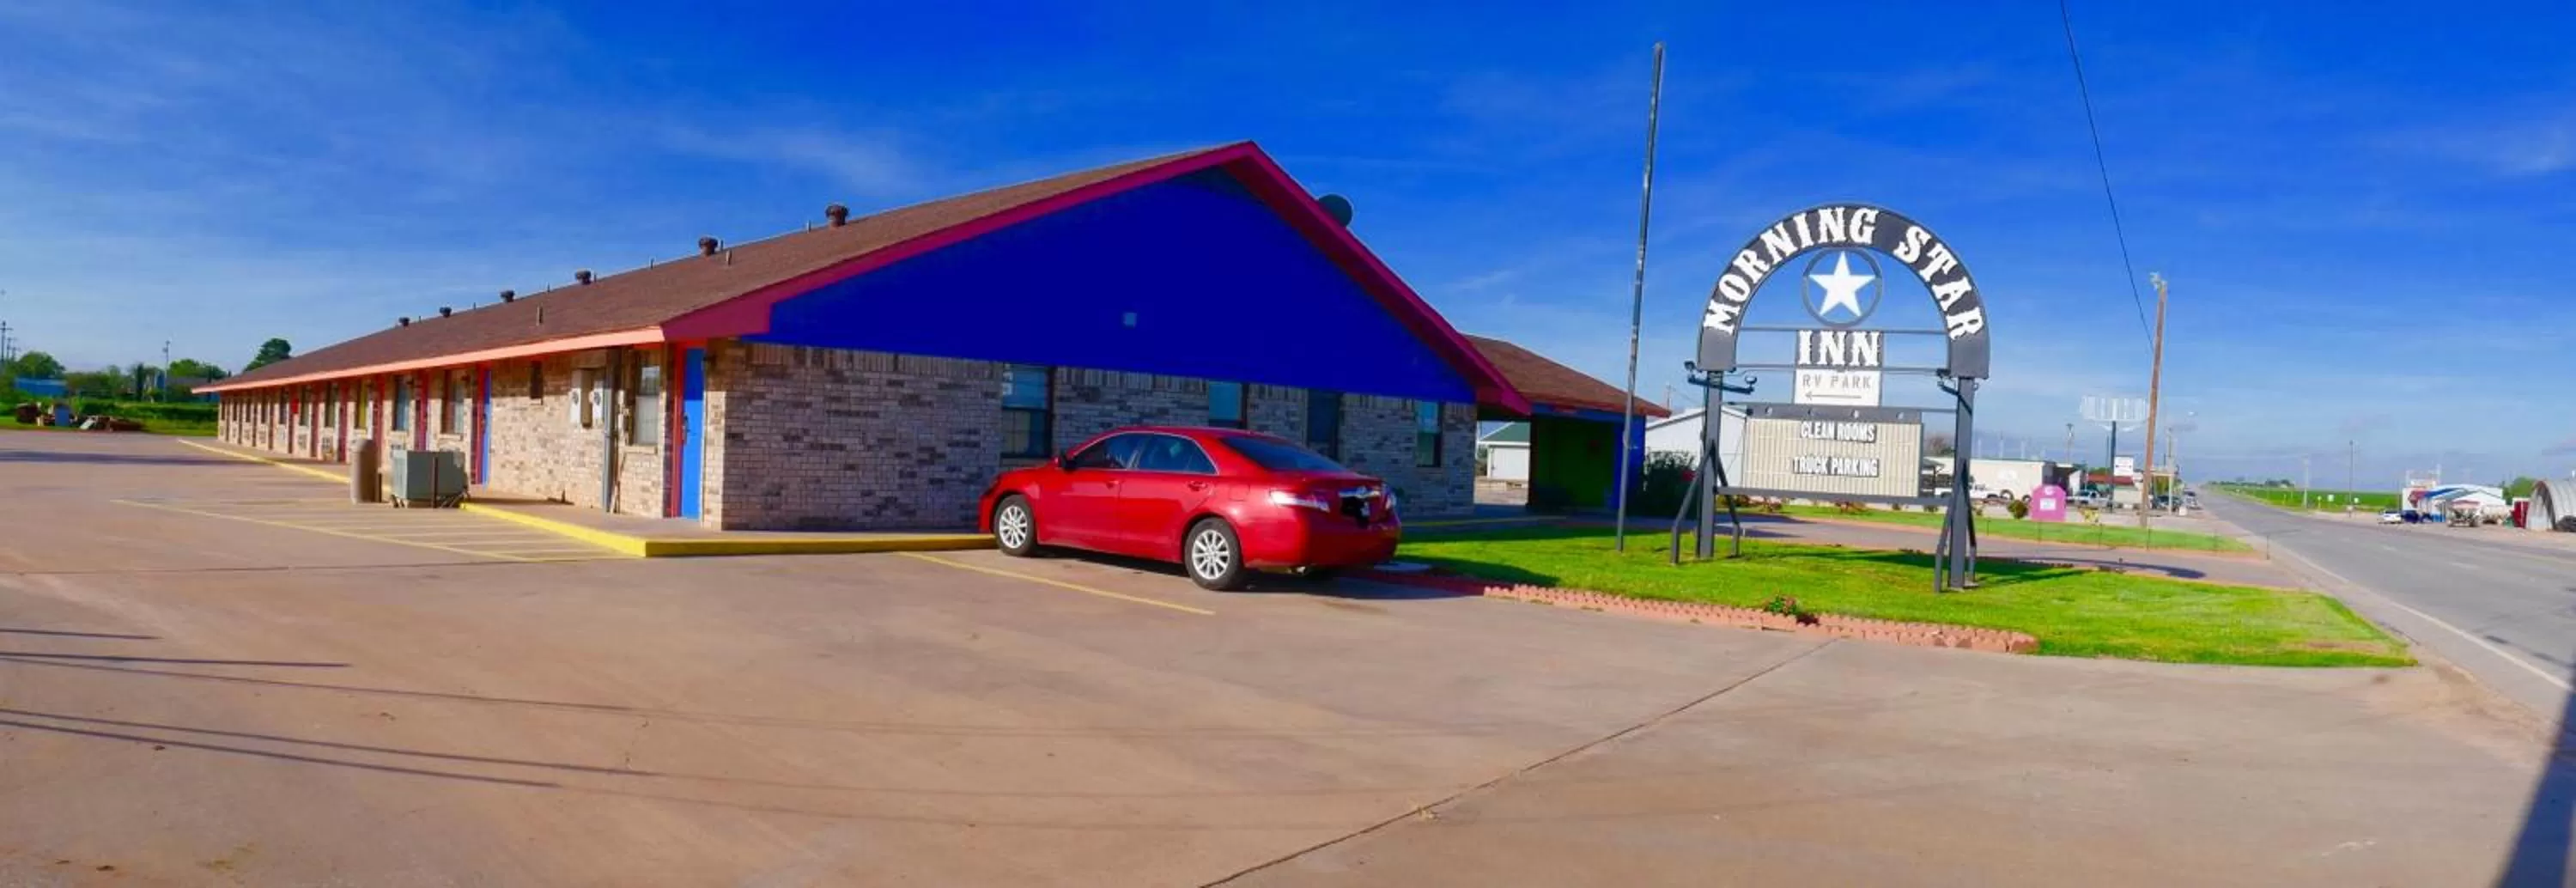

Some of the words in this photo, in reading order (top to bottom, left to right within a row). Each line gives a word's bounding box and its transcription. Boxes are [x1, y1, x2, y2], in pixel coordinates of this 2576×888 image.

[1703, 206, 1880, 335] MORNING
[1893, 225, 1985, 340] STAR
[1798, 330, 1883, 367] INN
[1802, 374, 1822, 387] RV
[1830, 375, 1871, 389] PARK
[1801, 420, 1835, 439] CLEAN
[1837, 422, 1876, 443] ROOMS
[1793, 456, 1827, 475] TRUCK
[1831, 457, 1879, 477] PARKING
